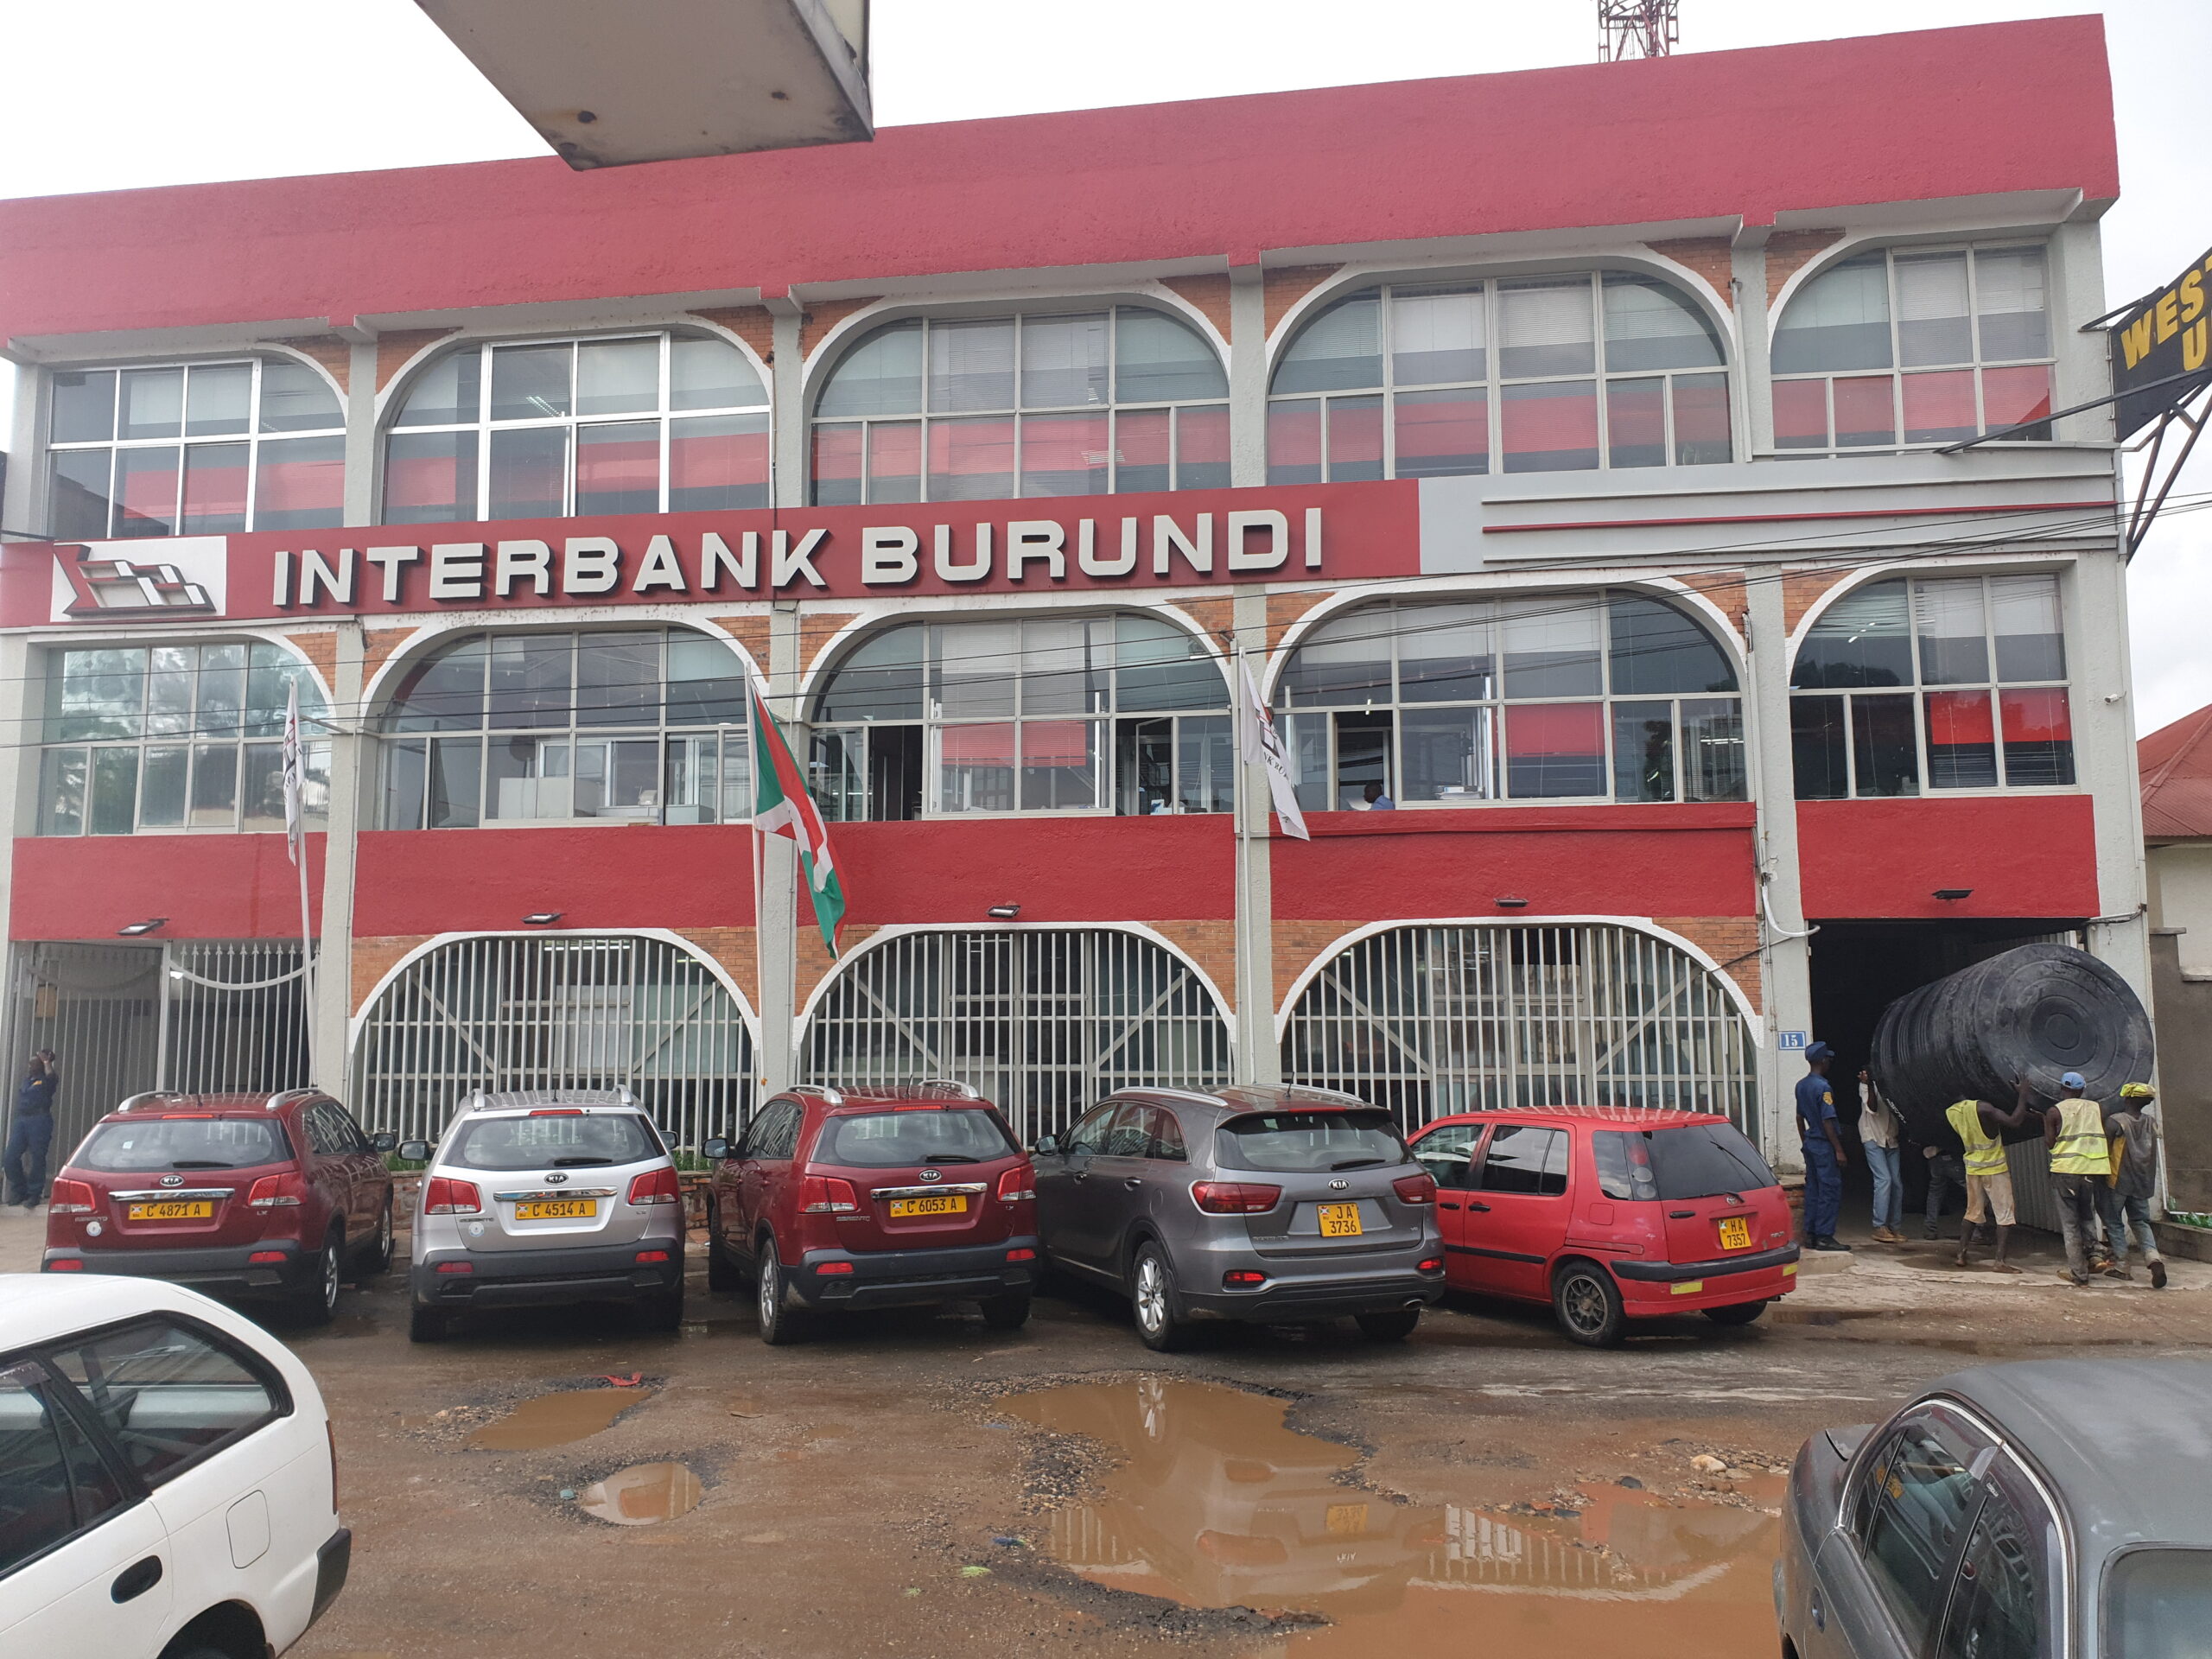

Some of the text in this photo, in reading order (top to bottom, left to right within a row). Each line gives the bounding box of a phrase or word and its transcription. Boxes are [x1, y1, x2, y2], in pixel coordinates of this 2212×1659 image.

[273, 507, 1323, 607] INTERBANK BURUNDI
[1784, 1034, 1798, 1047] 15
[146, 1203, 200, 1217] C 4871 A
[533, 1202, 585, 1217] C 4514 A
[906, 1198, 957, 1212] C 6053 A
[1330, 1220, 1357, 1234] 3736
[1727, 1234, 1745, 1248] 7357
